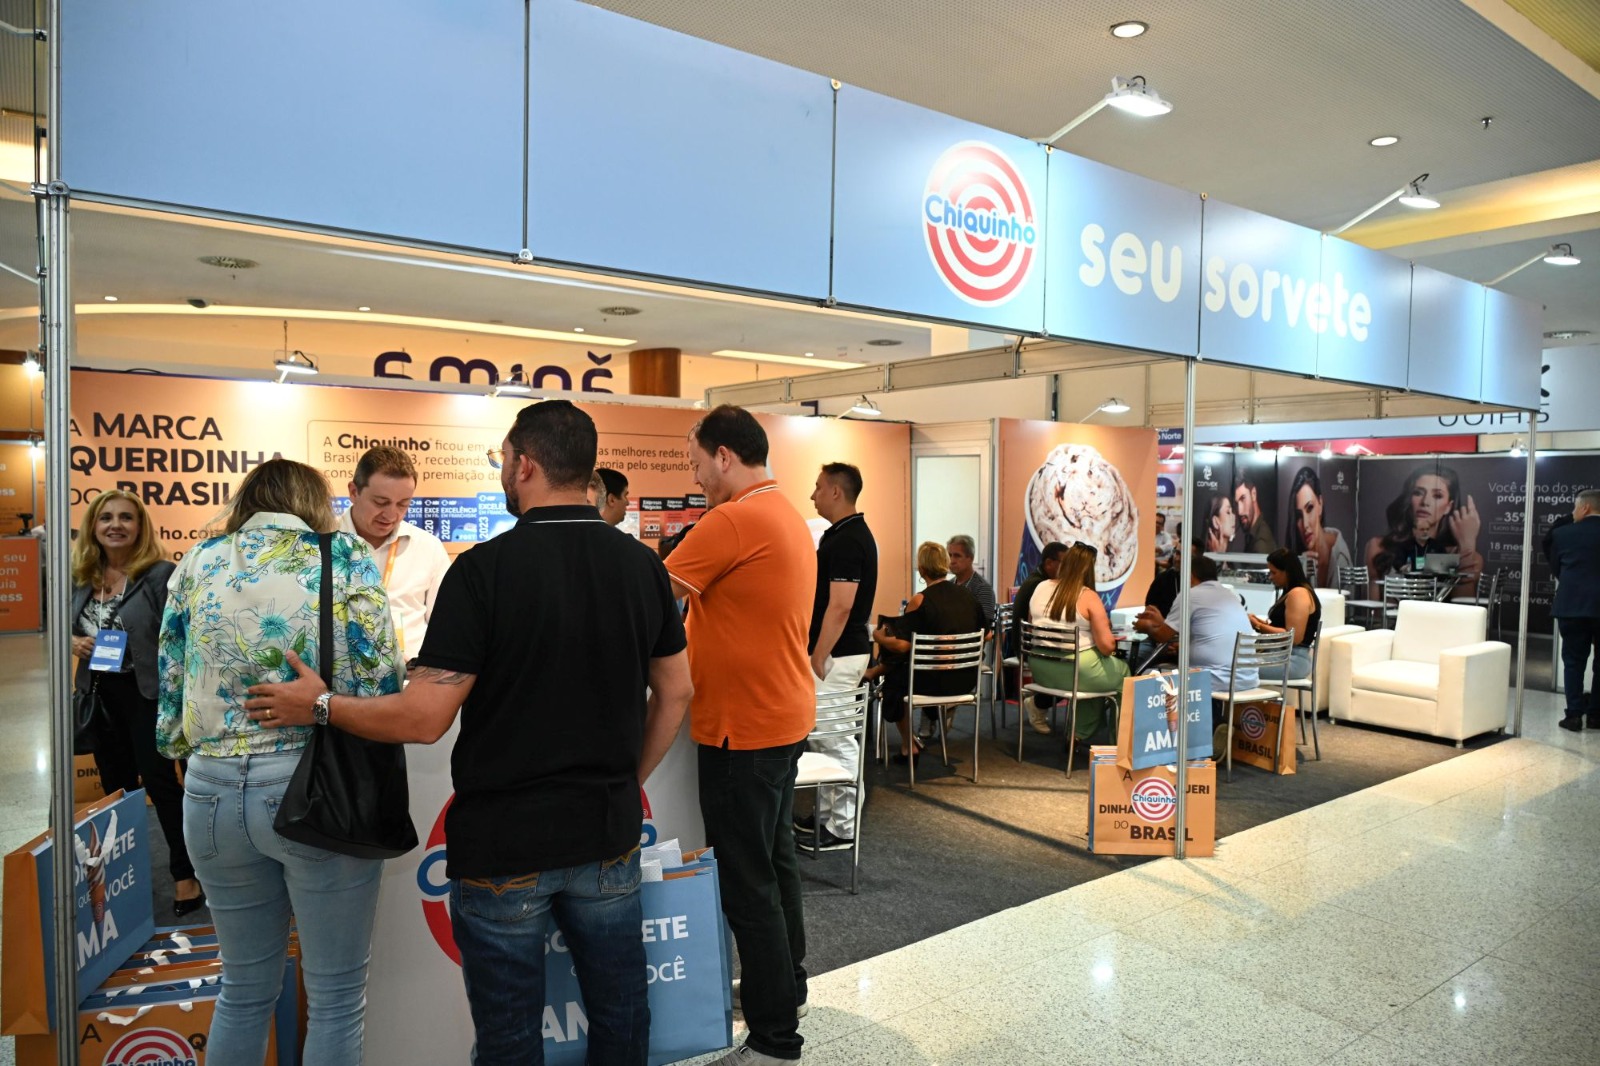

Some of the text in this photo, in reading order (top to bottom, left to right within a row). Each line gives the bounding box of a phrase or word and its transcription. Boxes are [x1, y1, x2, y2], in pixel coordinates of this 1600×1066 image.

[925, 194, 1035, 245] Chiquinho
[1079, 223, 1372, 343] seu sorvete
[70, 412, 223, 441] A MARCA
[323, 436, 333, 447] A
[435, 440, 464, 451] ficou
[467, 443, 487, 451] em
[611, 446, 657, 458] melhores
[659, 448, 685, 459] redes
[324, 451, 359, 463] Brasil
[425, 455, 487, 466] recebendo
[627, 459, 648, 471] pelo
[650, 461, 690, 473] segundo
[423, 470, 484, 482] premiação
[1488, 481, 1517, 493] Você
[1552, 482, 1569, 493] do
[441, 519, 451, 540] 2022
[1490, 541, 1501, 550] 18
[1122, 769, 1133, 781] A
[1131, 793, 1177, 804] Chiquinho
[1099, 804, 1136, 814] DINHA
[1114, 820, 1129, 830] DO
[1130, 825, 1194, 842] BRASL
[104, 863, 136, 903] VOCÊ
[80, 1023, 103, 1045] A
